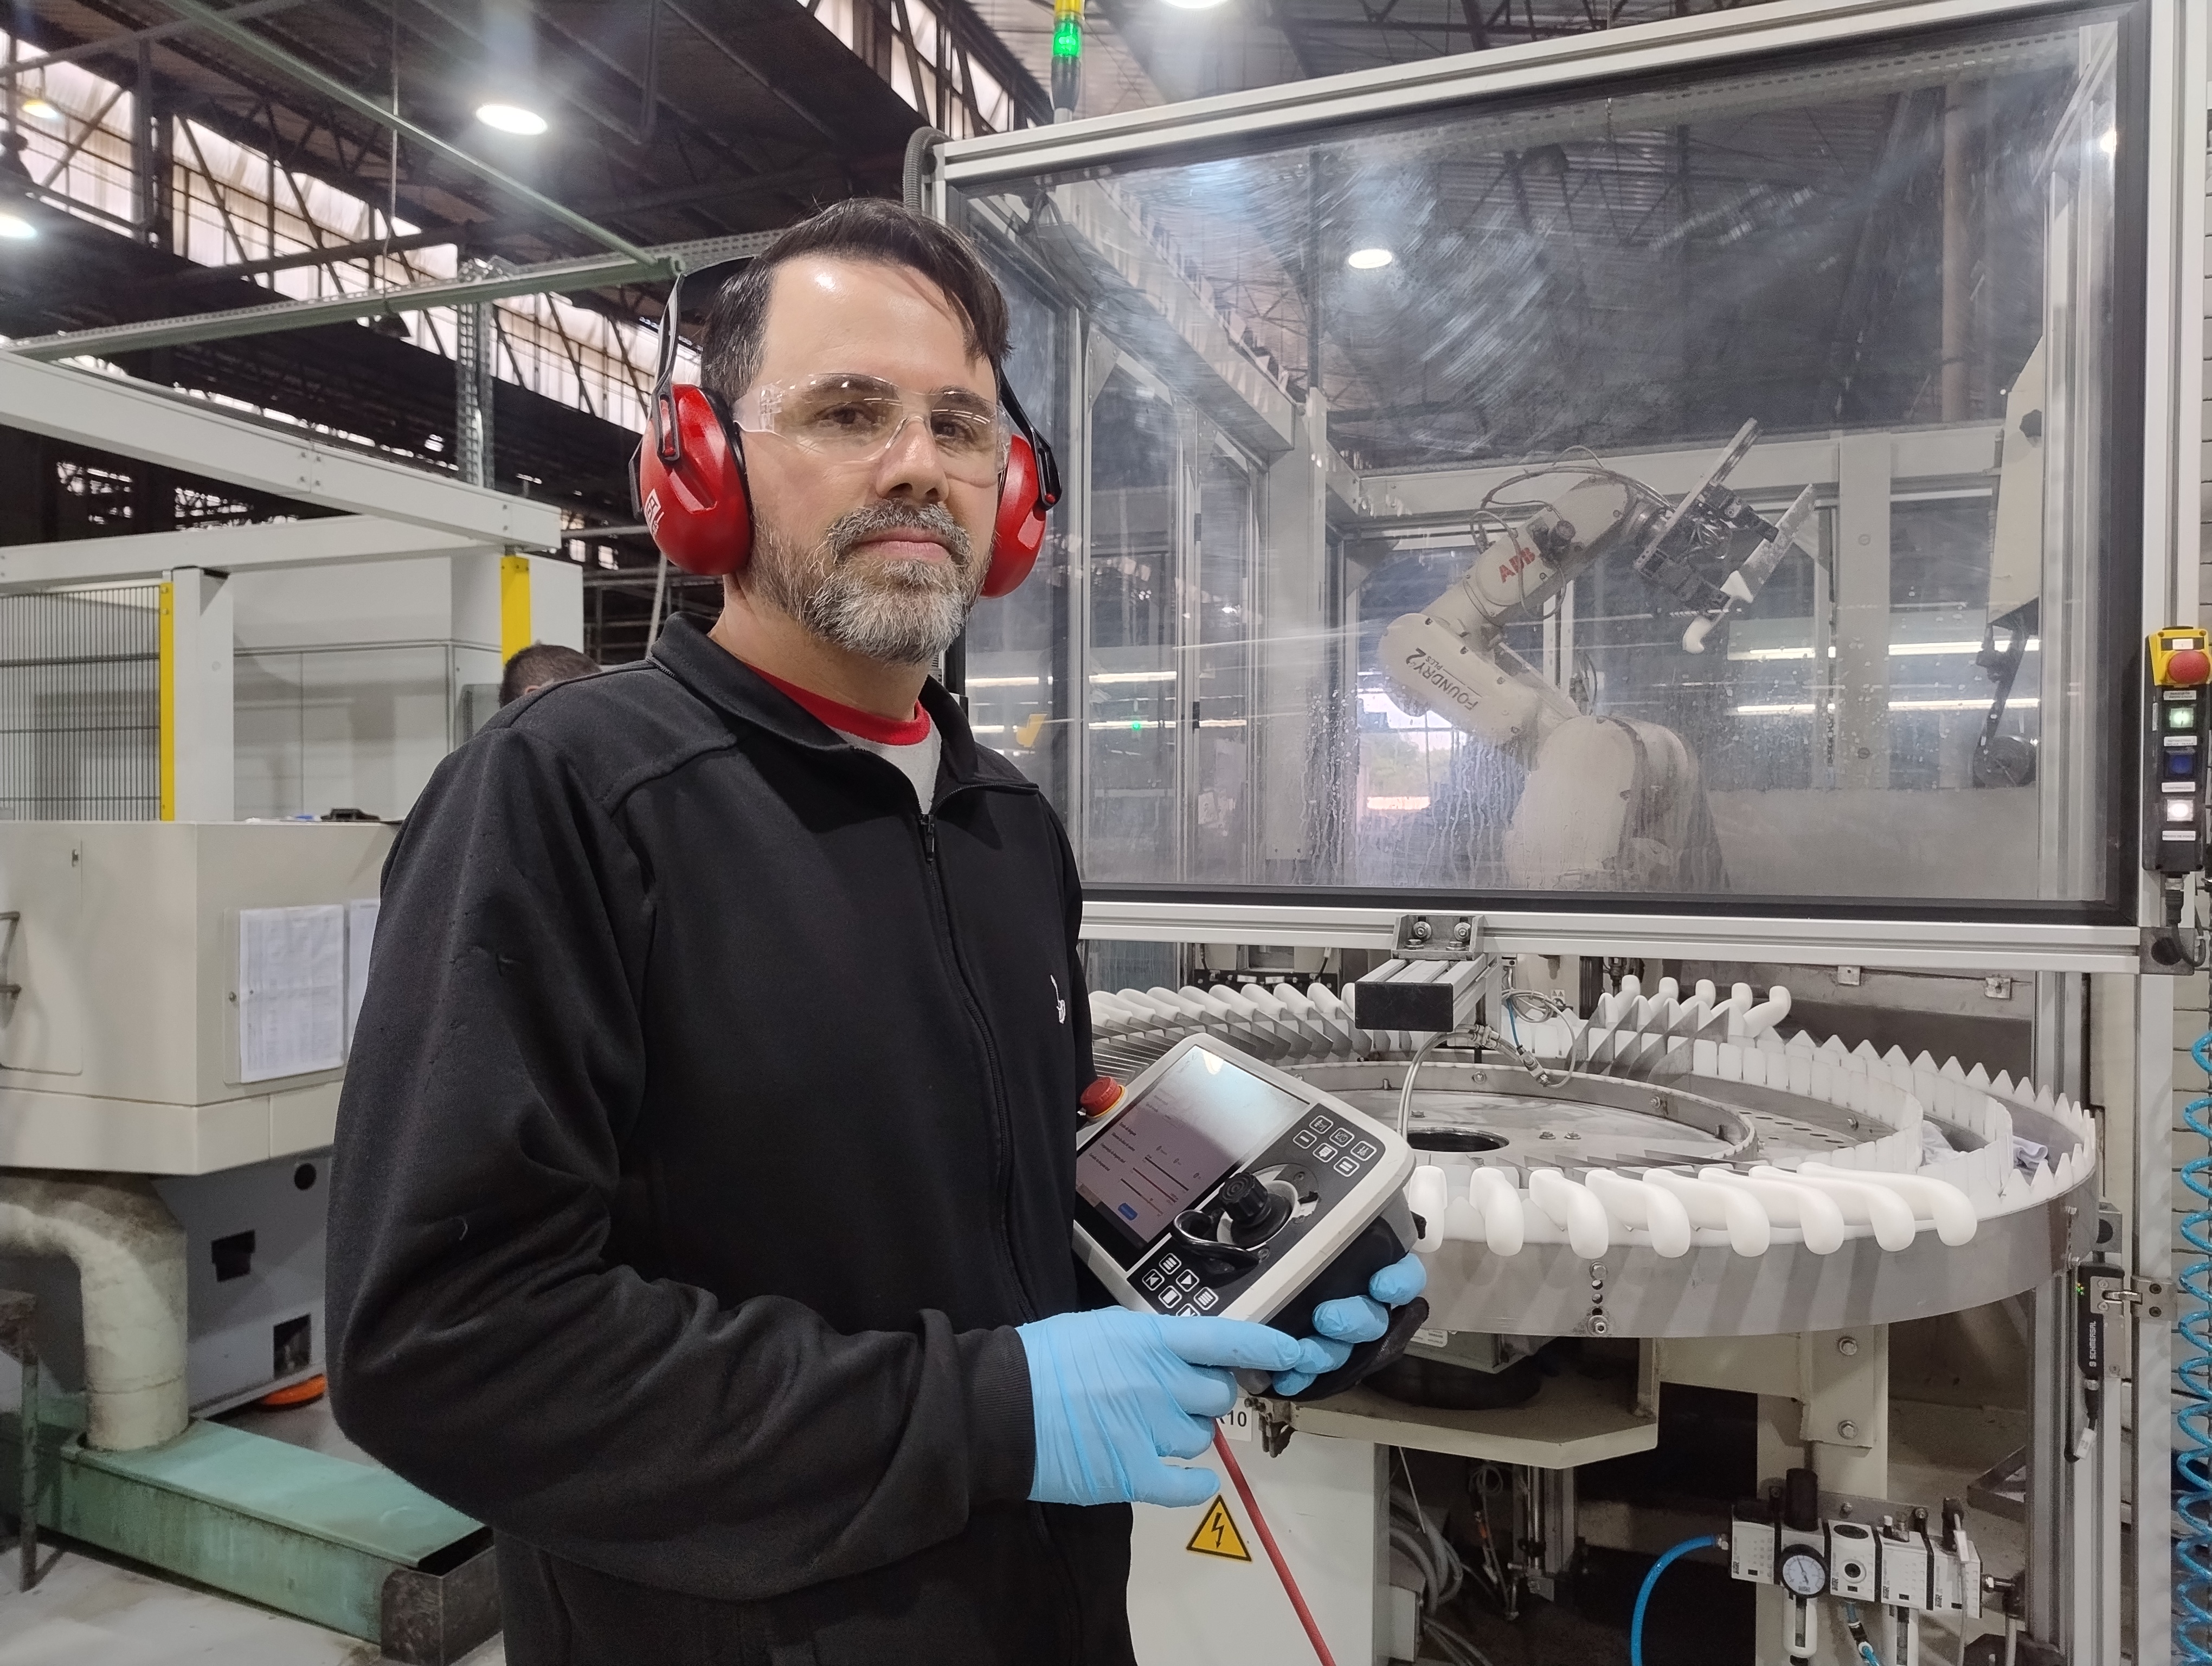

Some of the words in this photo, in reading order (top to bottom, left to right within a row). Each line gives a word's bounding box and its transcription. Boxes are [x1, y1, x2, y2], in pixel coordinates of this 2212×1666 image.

[1499, 547, 1535, 584] ABB
[1405, 647, 1426, 665] 2
[1413, 662, 1478, 711] FOUNDRY
[1219, 1409, 1247, 1427] 10
